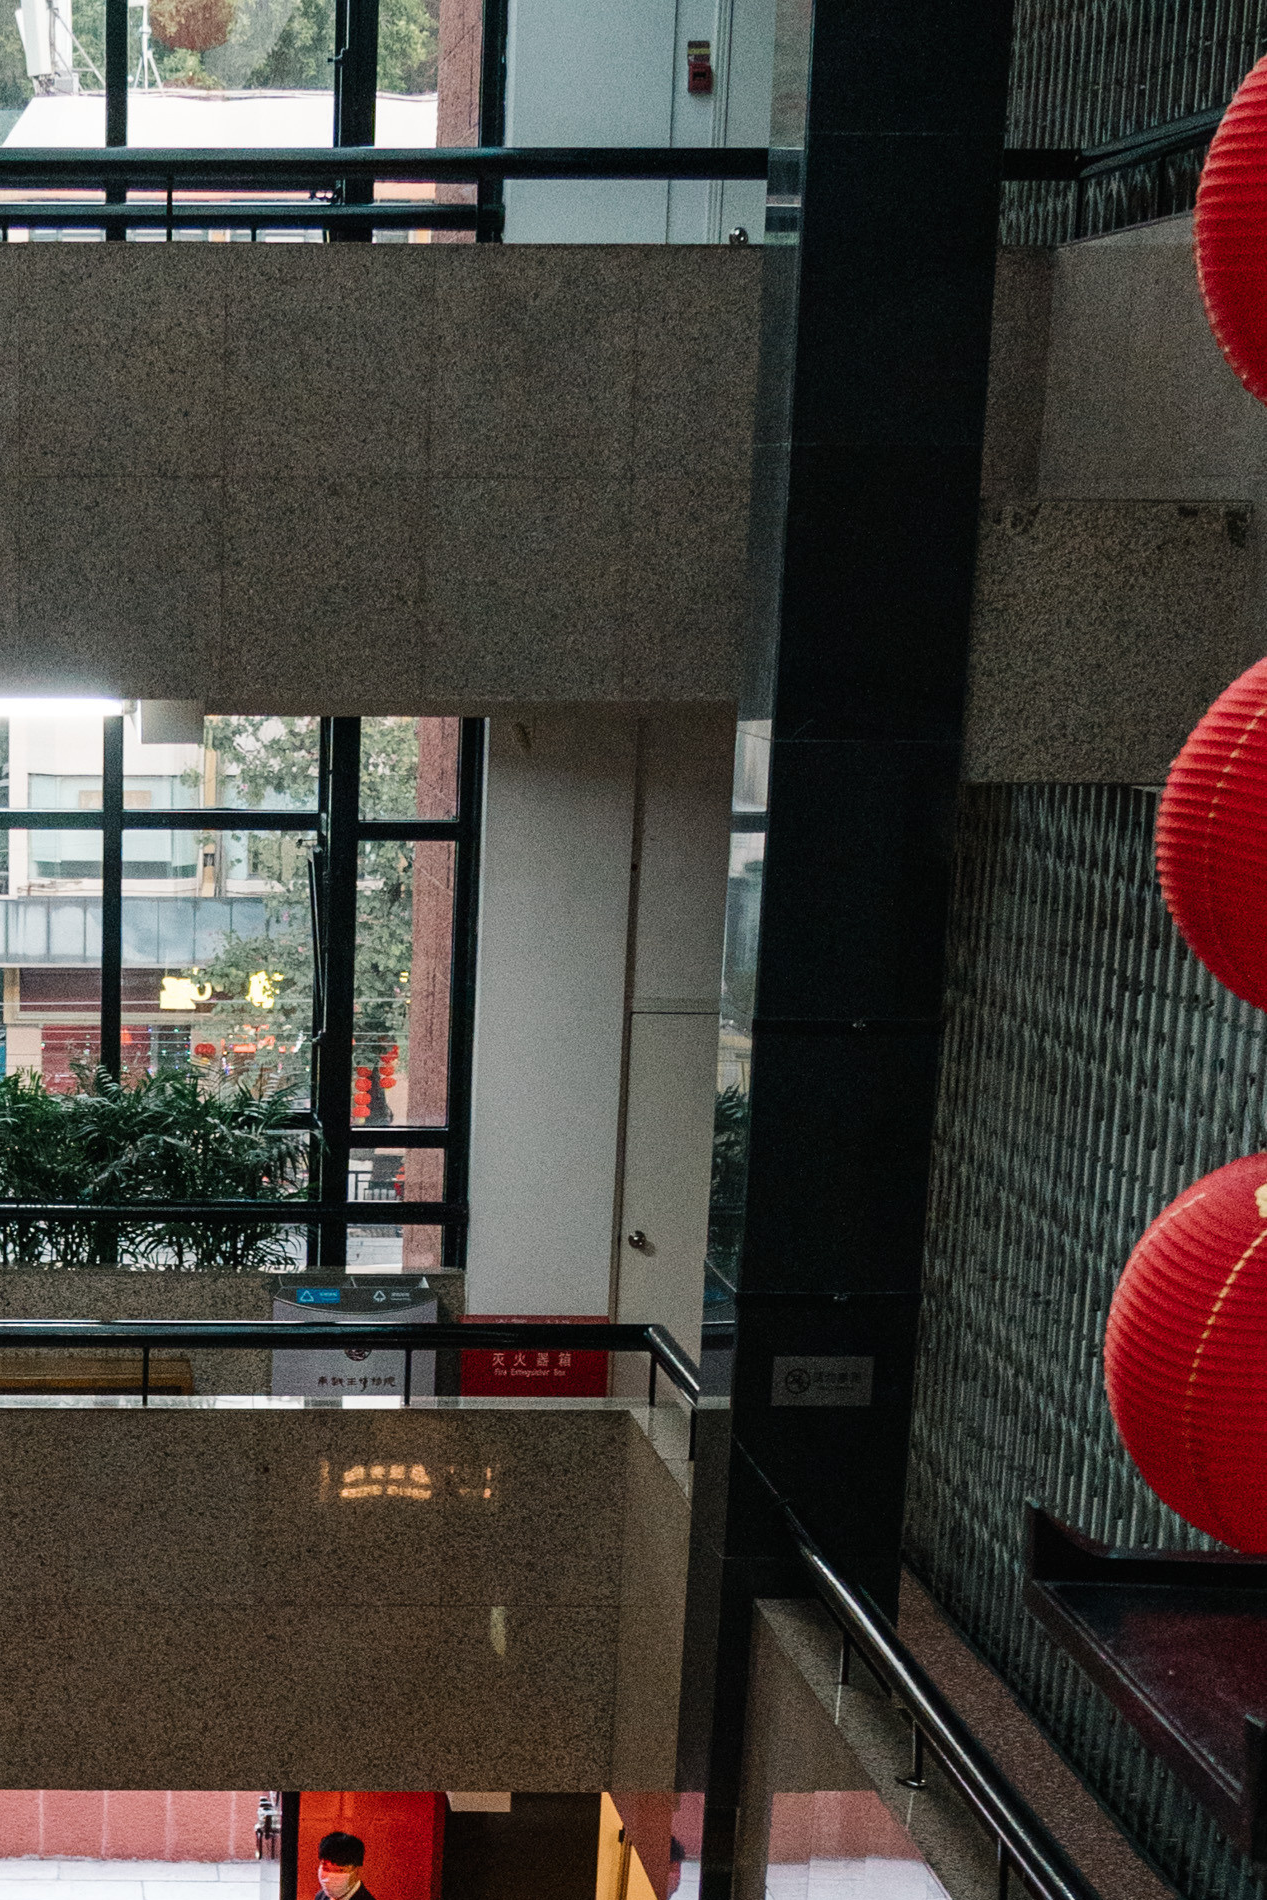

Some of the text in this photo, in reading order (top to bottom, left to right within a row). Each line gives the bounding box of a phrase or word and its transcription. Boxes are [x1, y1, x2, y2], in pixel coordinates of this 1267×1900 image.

[492, 1352, 572, 1367] 灭火器箱
[494, 1368, 507, 1376] Fire
